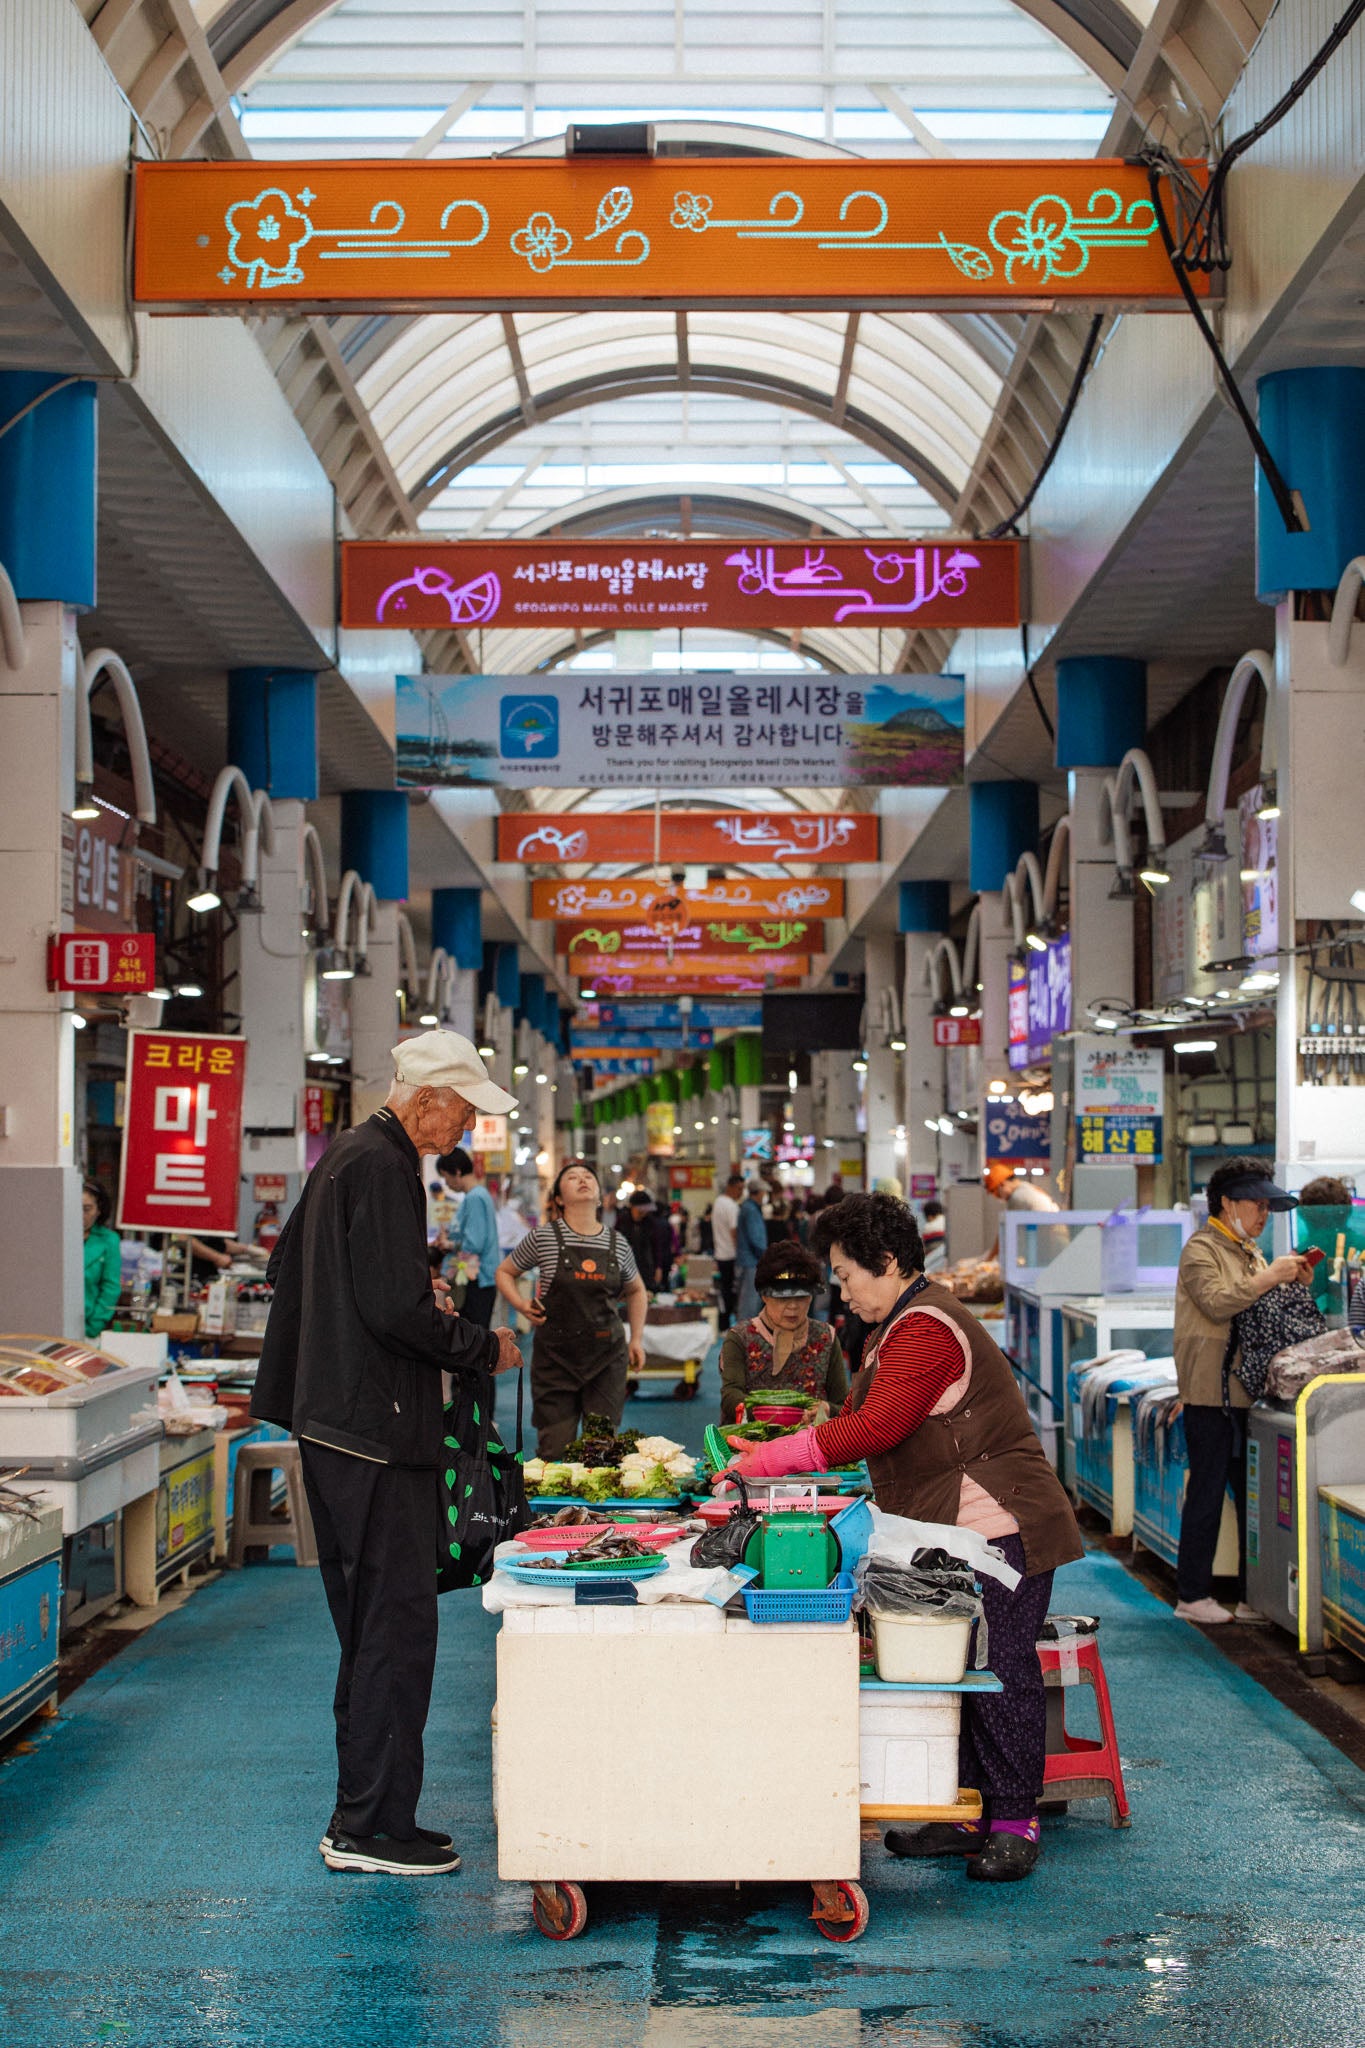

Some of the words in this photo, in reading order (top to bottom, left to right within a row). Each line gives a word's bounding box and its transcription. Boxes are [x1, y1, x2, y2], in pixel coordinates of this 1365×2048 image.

[513, 558, 709, 595] 서귀포매일올레시장
[624, 602, 655, 613] OLLE
[658, 602, 709, 613] MARKET
[579, 686, 864, 717] 서귀포매일올레시장을
[592, 724, 724, 748] 방문해주셔서
[734, 723, 851, 748] 감사합니다.
[606, 758, 635, 767] Thank
[637, 759, 654, 768] you
[656, 758, 671, 767] for
[144, 1044, 235, 1075] 크라운
[145, 1081, 218, 1207] 마트
